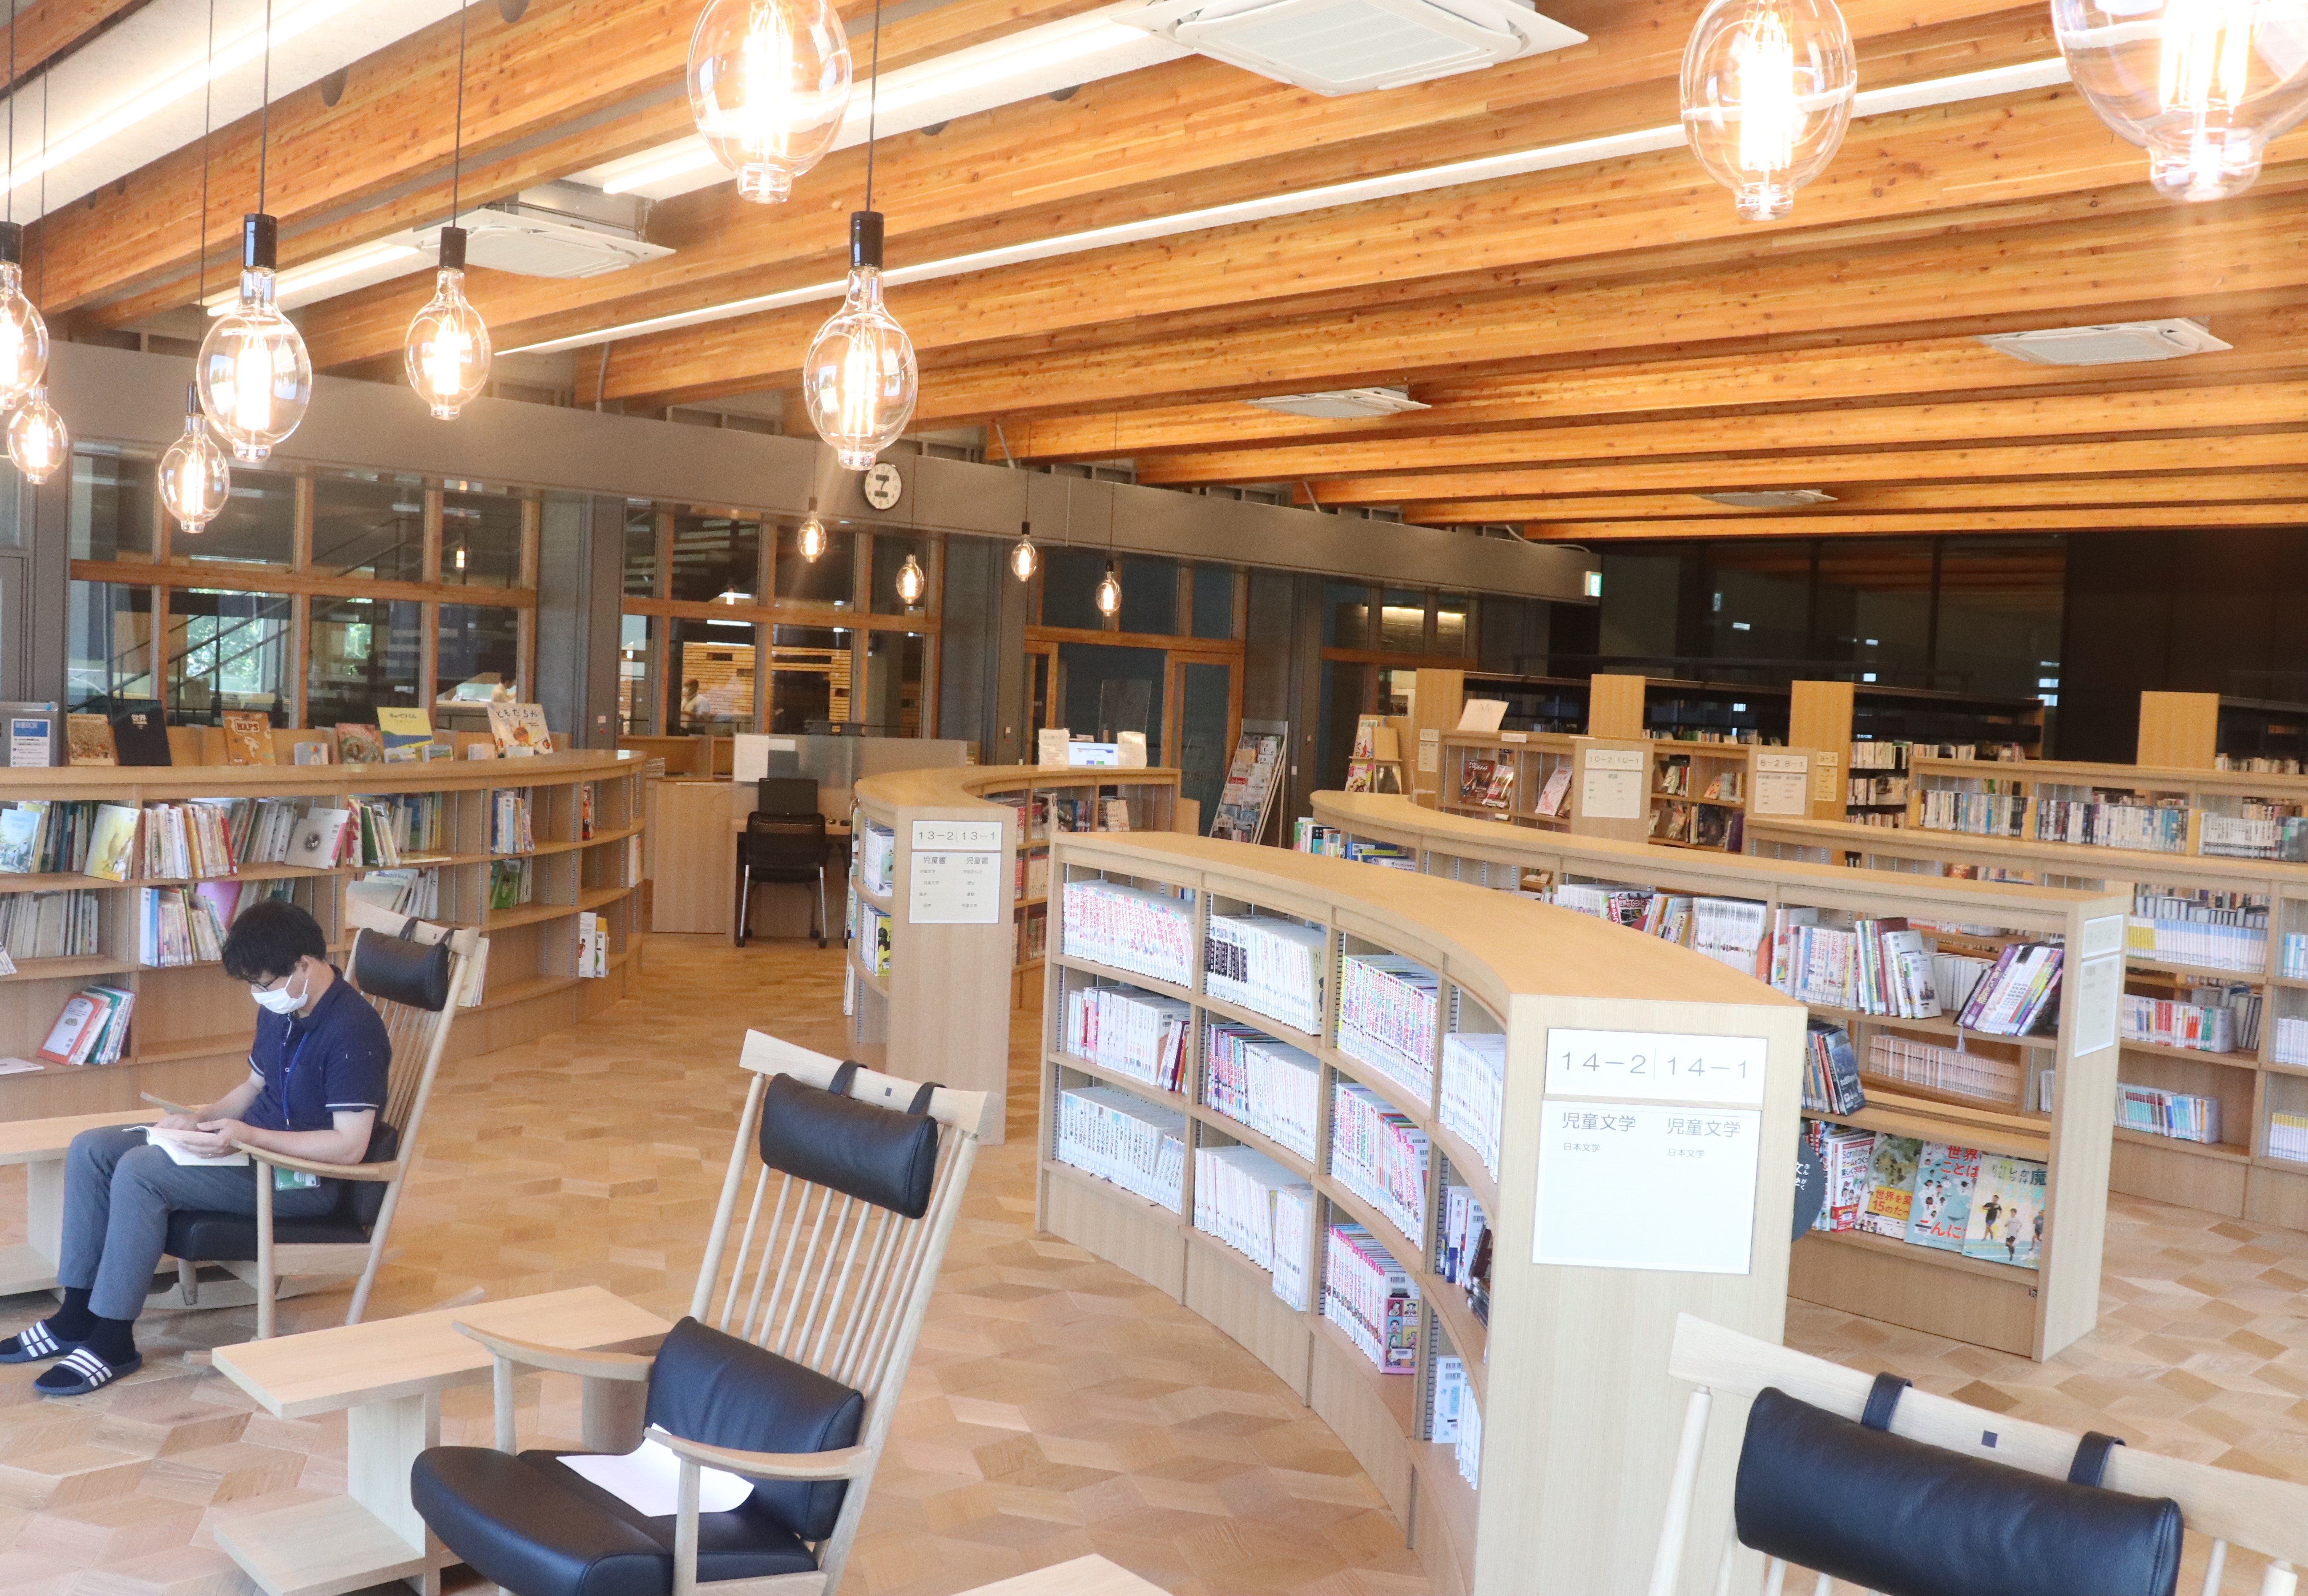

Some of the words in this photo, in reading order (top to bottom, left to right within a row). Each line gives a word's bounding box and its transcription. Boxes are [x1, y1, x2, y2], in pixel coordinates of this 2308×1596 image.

[495, 708, 538, 719] ともだちや
[237, 723, 258, 731] MAPS
[923, 856, 946, 864] 児童書
[966, 856, 988, 864] 児童書
[1562, 1052, 1646, 1074] 14-2
[1667, 1056, 1748, 1078] 14-1
[1562, 1111, 1636, 1133] 児童文学
[1667, 1117, 1741, 1138] 児童文学
[1563, 1142, 1600, 1152] 日本文学
[1668, 1148, 1705, 1158] 日本文学
